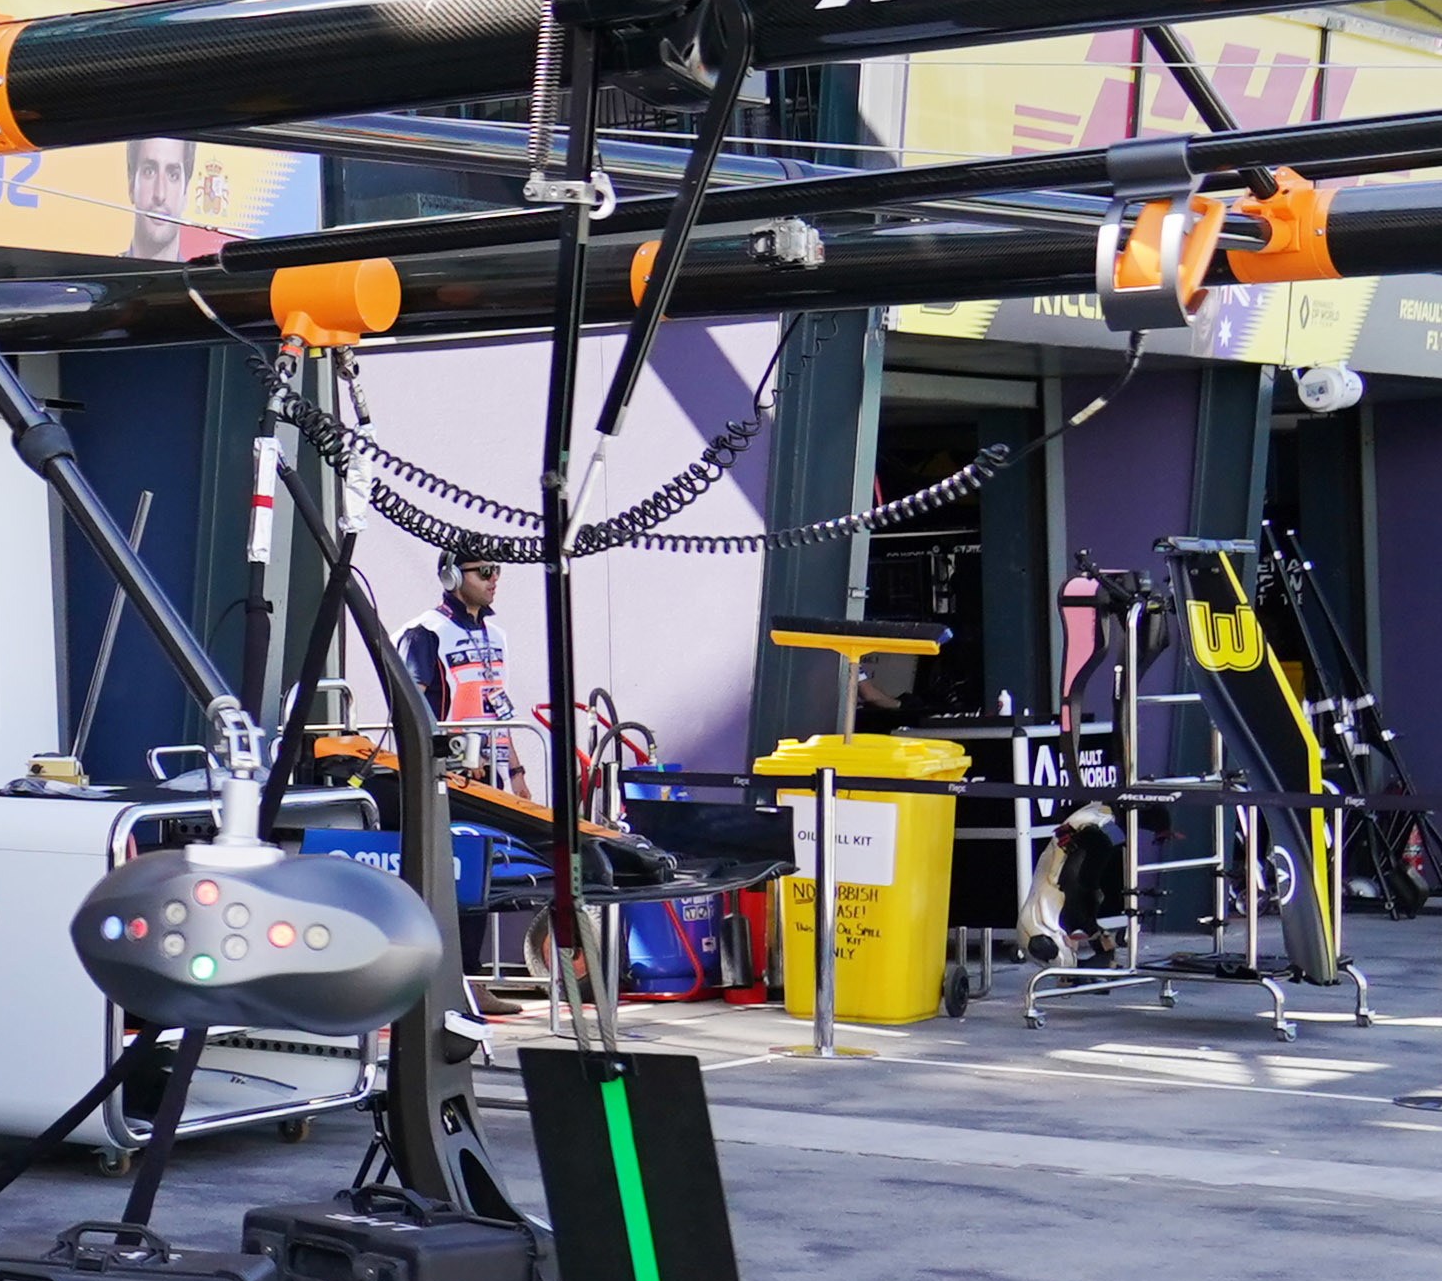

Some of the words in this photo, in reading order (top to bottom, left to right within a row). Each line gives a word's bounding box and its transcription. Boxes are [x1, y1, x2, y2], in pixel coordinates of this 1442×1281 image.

[1399, 298, 1442, 323] RENAUL
[1117, 791, 1176, 803] McLaren
[797, 830, 817, 841] OIL
[853, 835, 873, 846] KIT
[793, 883, 816, 902] NO
[834, 885, 879, 903] BBISH
[836, 905, 866, 919] ASE!
[833, 948, 856, 960] NLY
